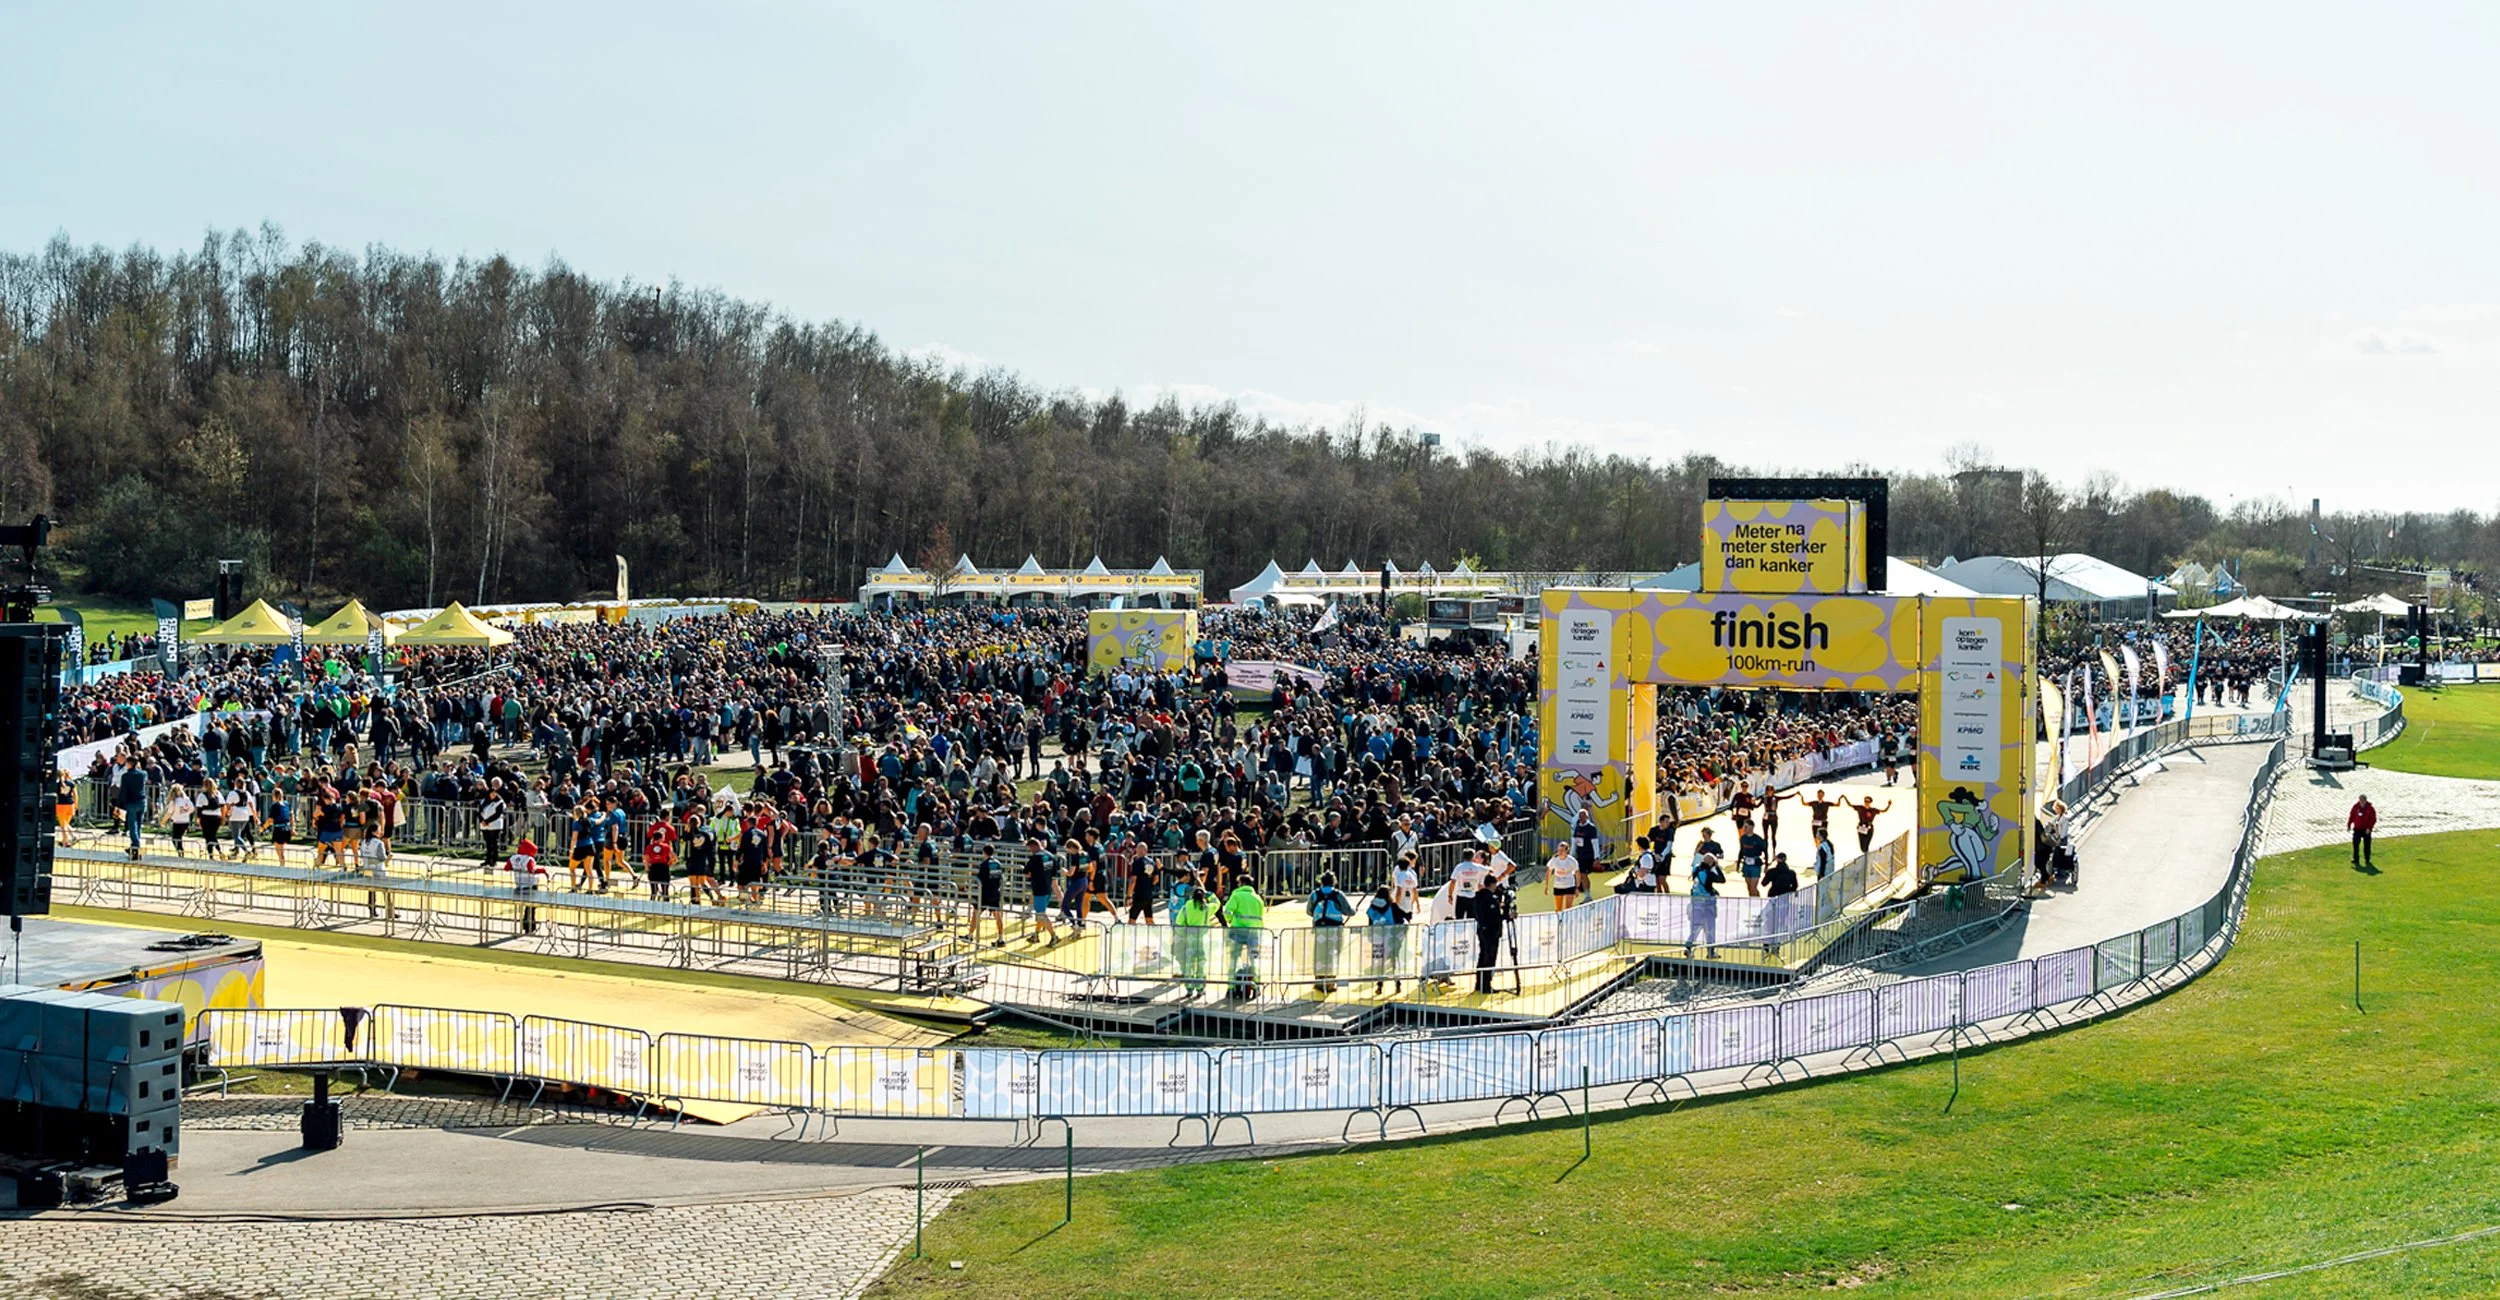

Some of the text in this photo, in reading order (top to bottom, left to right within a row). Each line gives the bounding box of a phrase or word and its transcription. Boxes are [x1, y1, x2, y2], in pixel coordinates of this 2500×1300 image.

[1735, 524, 1805, 539] Meter na
[1721, 540, 1827, 554] meter sterker
[1725, 554, 1814, 573] dan kanker
[1710, 610, 1828, 650] finish
[1726, 654, 1815, 672] 100km-run
